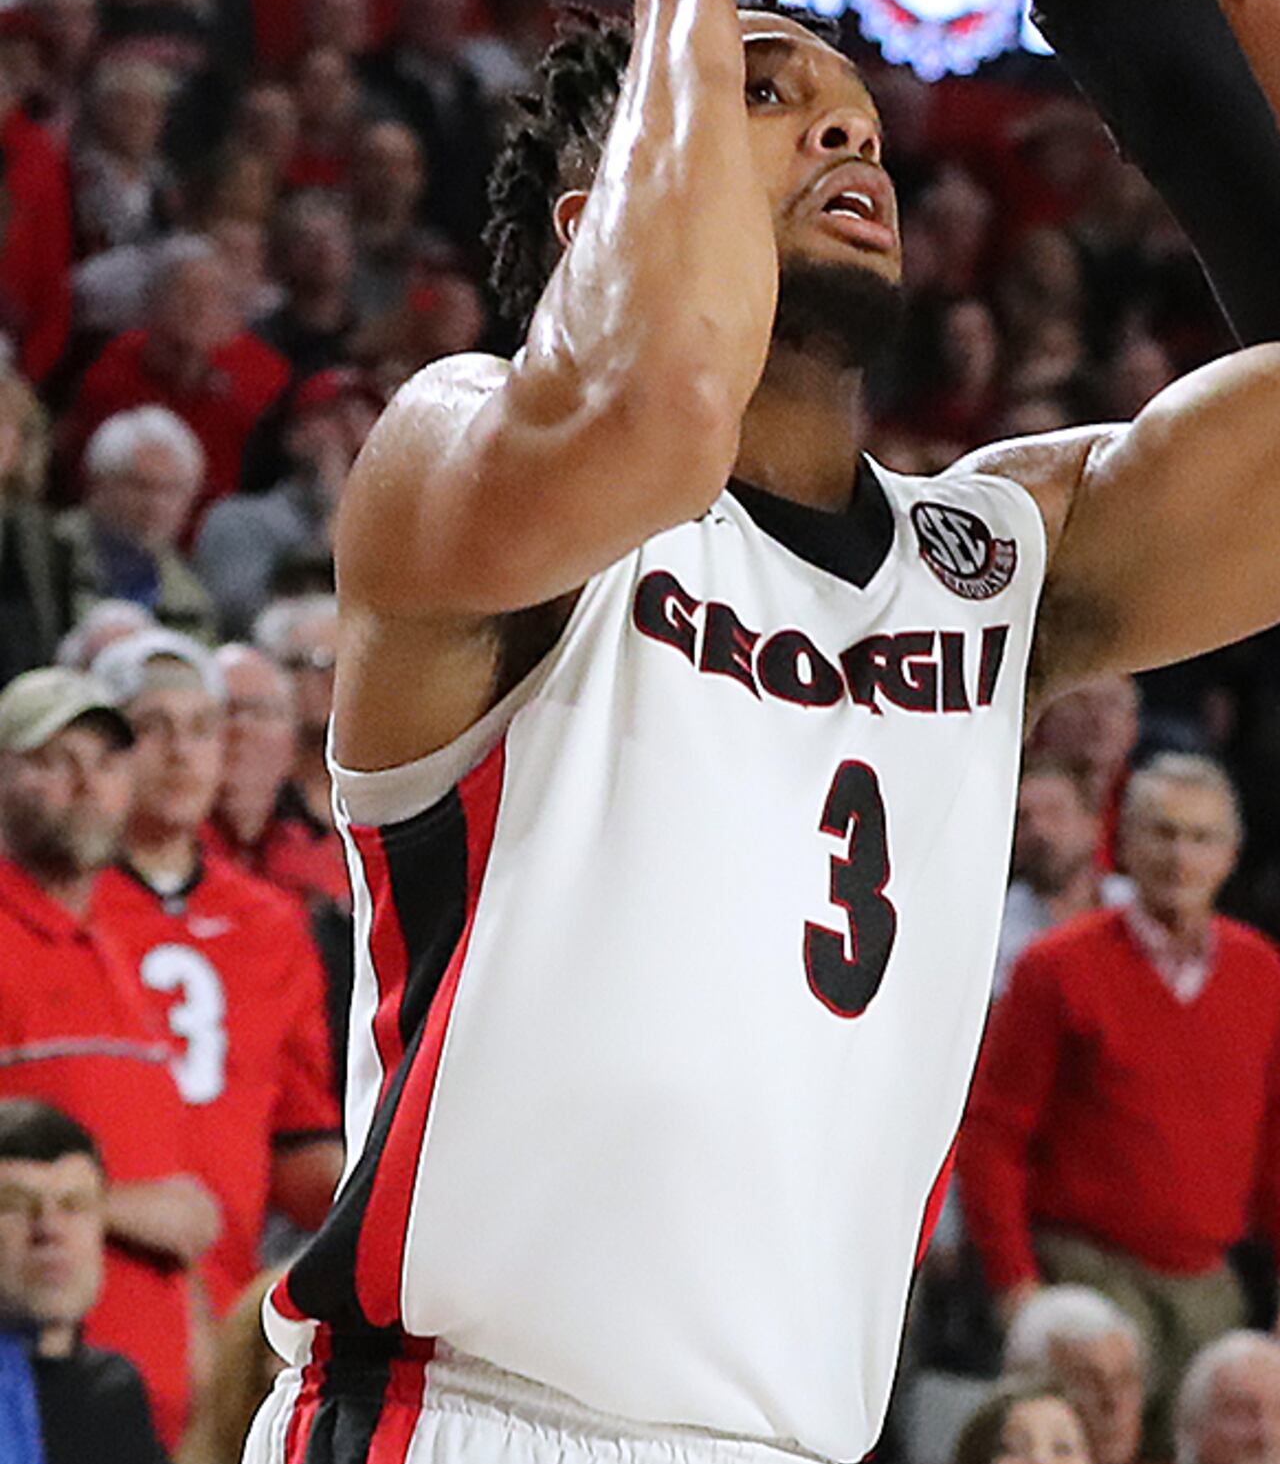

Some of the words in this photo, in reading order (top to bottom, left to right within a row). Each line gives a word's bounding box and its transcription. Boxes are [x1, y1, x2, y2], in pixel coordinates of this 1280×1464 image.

[916, 505, 986, 576] SEC
[804, 759, 898, 1019] 3
[140, 942, 227, 1105] 3
